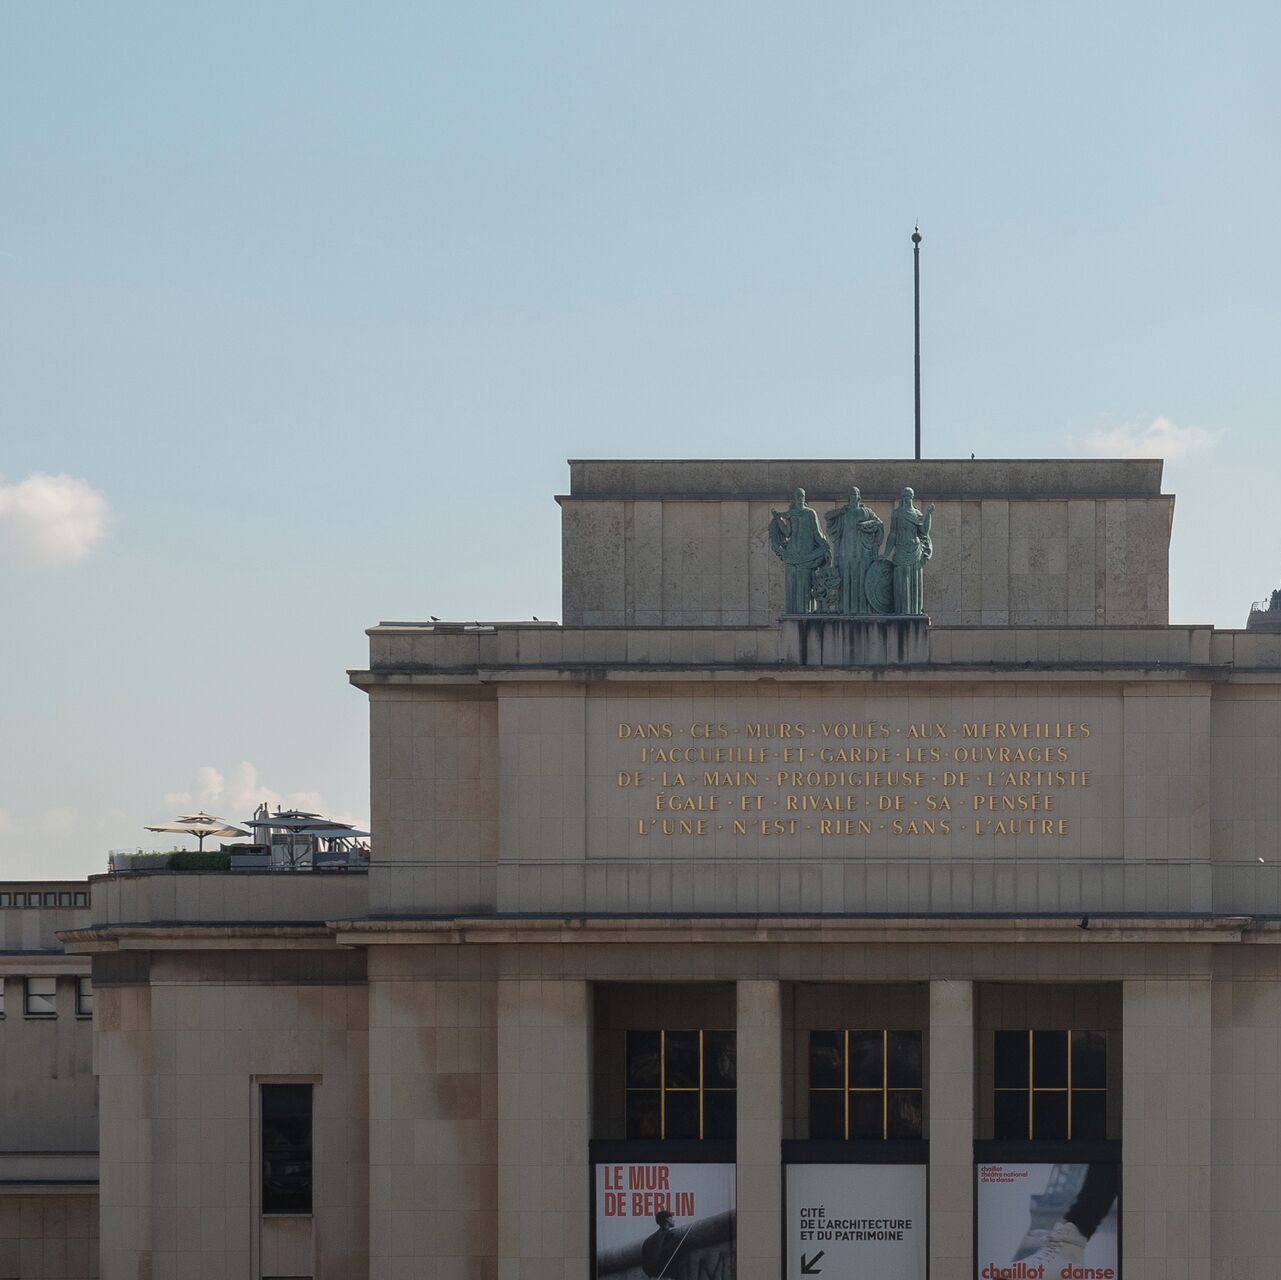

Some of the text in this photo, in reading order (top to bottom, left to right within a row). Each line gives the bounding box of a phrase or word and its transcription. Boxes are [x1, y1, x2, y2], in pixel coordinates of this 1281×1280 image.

[618, 721, 1091, 738] DANS CES MURS VOUÉS AUX MERVEILLES
[641, 747, 1068, 762] J'ACCUEILLE ET GARDE LES OUVRAGES
[617, 772, 1092, 787] DE LA MAIN PRODIGIEUSE DE L'ARTISTE
[656, 792, 1054, 811] ÉGALE ET RIVALE DE SA PENSÉE
[638, 819, 1069, 835] L'UNE N'EST RIEN SANS L'AUTRE
[604, 1166, 670, 1190] LE MUR
[604, 1192, 695, 1217] DE BERLIN
[801, 1205, 825, 1218] CITÉ
[801, 1219, 913, 1230] DE L'ARCHITECTURE
[801, 1230, 904, 1241] ET DU PATRIMOINE
[982, 1263, 1115, 1280] chaillot danse
